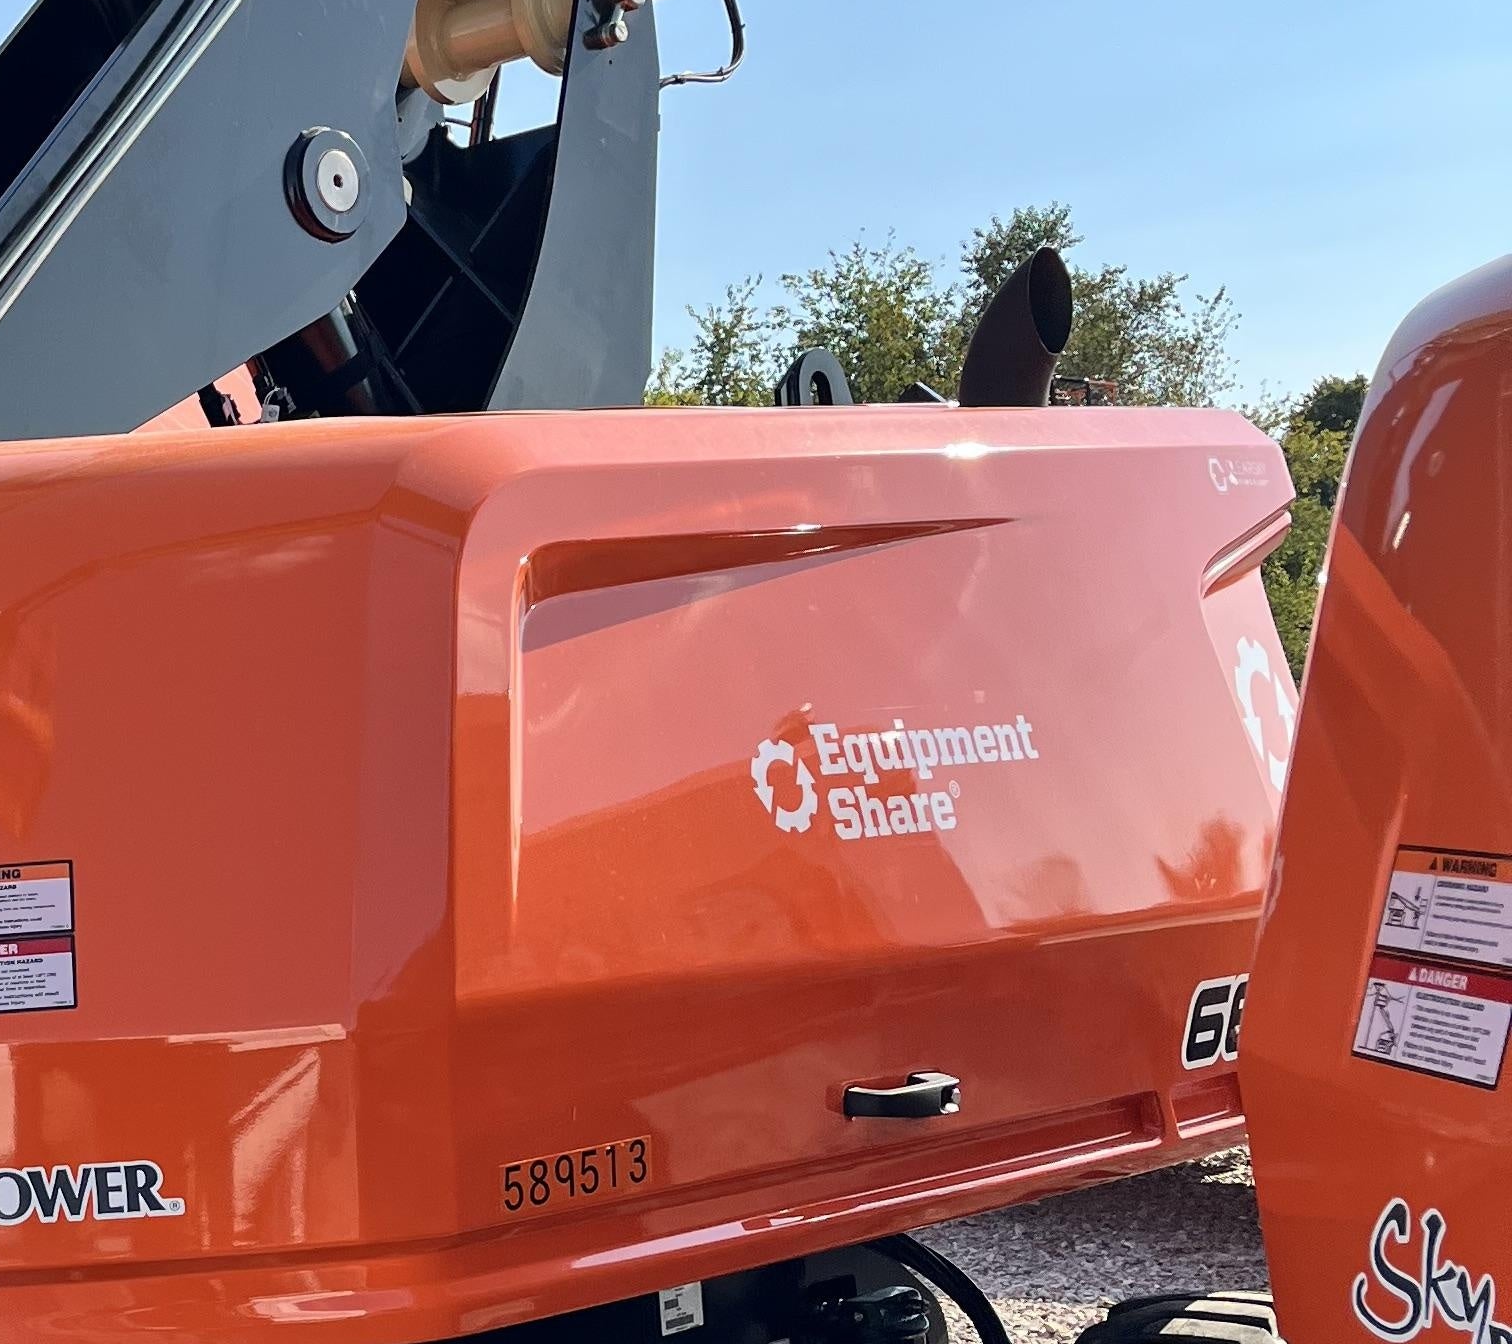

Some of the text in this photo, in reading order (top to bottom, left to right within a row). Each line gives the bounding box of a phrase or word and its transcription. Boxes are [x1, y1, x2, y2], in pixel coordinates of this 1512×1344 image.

[808, 714, 1039, 784] Equipment
[827, 785, 957, 840] Share
[1418, 967, 1468, 991] DANGER
[503, 1138, 648, 1211] 589513
